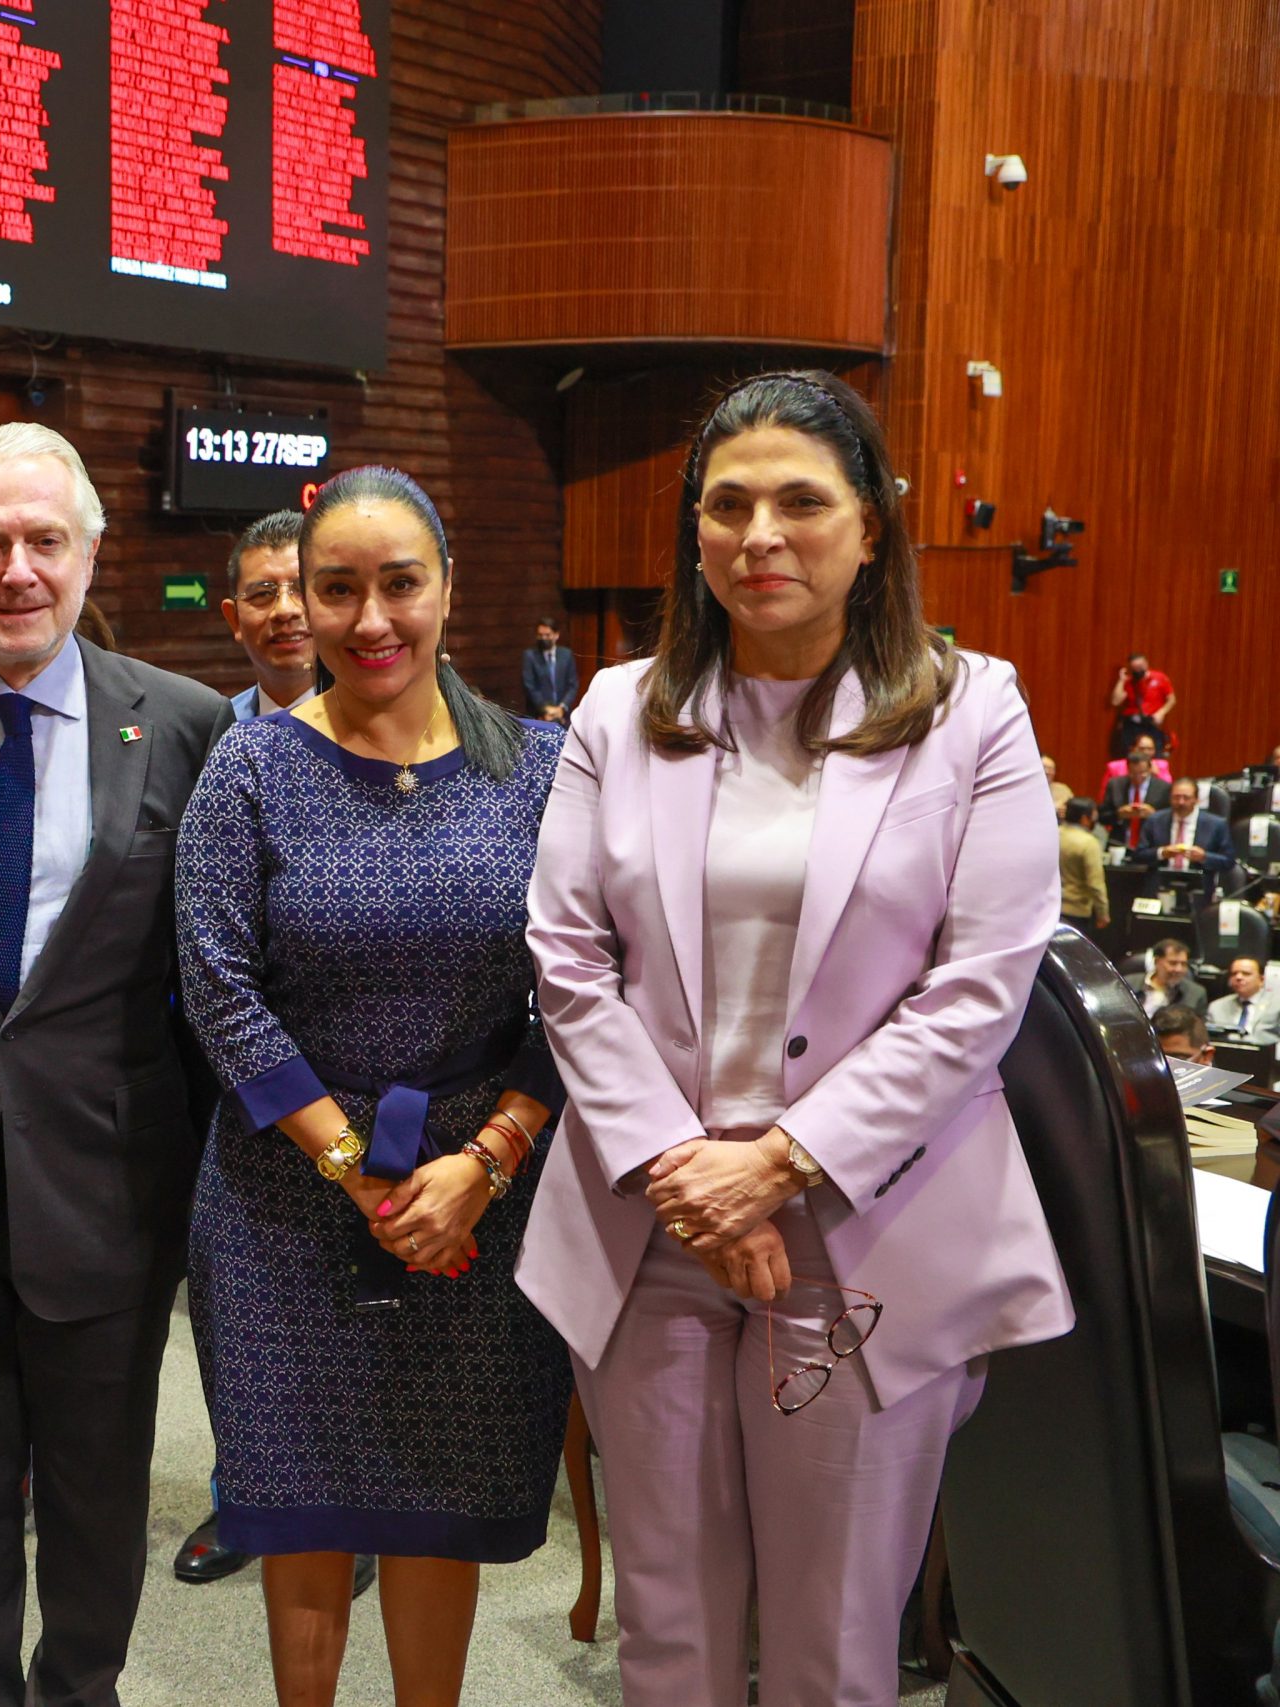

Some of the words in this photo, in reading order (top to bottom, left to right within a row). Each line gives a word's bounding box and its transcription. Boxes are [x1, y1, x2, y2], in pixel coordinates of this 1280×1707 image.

[20, 44, 61, 69] ANGELICA
[186, 427, 248, 463] 13:13
[251, 431, 327, 467] 27/SEP
